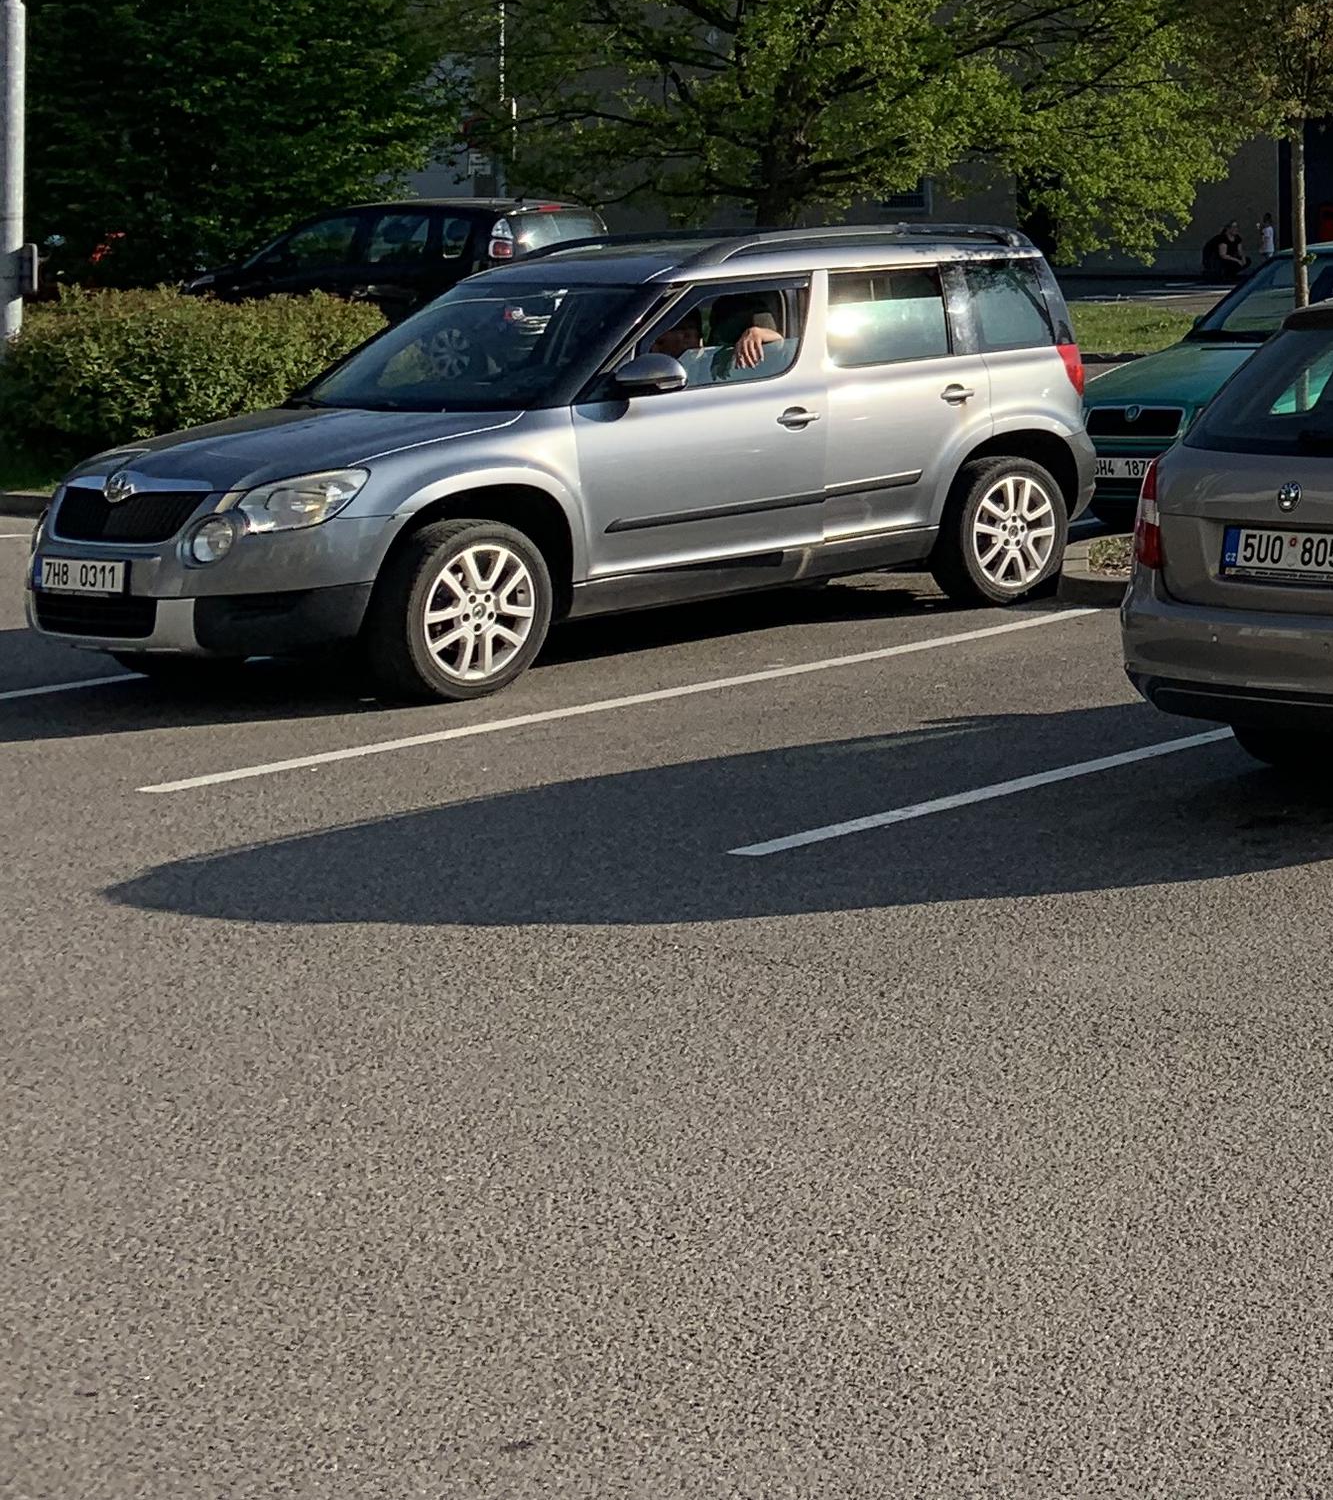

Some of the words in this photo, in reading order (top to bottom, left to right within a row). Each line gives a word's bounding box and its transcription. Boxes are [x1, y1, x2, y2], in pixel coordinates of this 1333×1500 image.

[1125, 460, 1151, 476] 187
[1225, 552, 1236, 562] CZ
[1242, 534, 1283, 564] 5U0
[44, 561, 69, 585] 7H8
[80, 564, 115, 588] 0311
